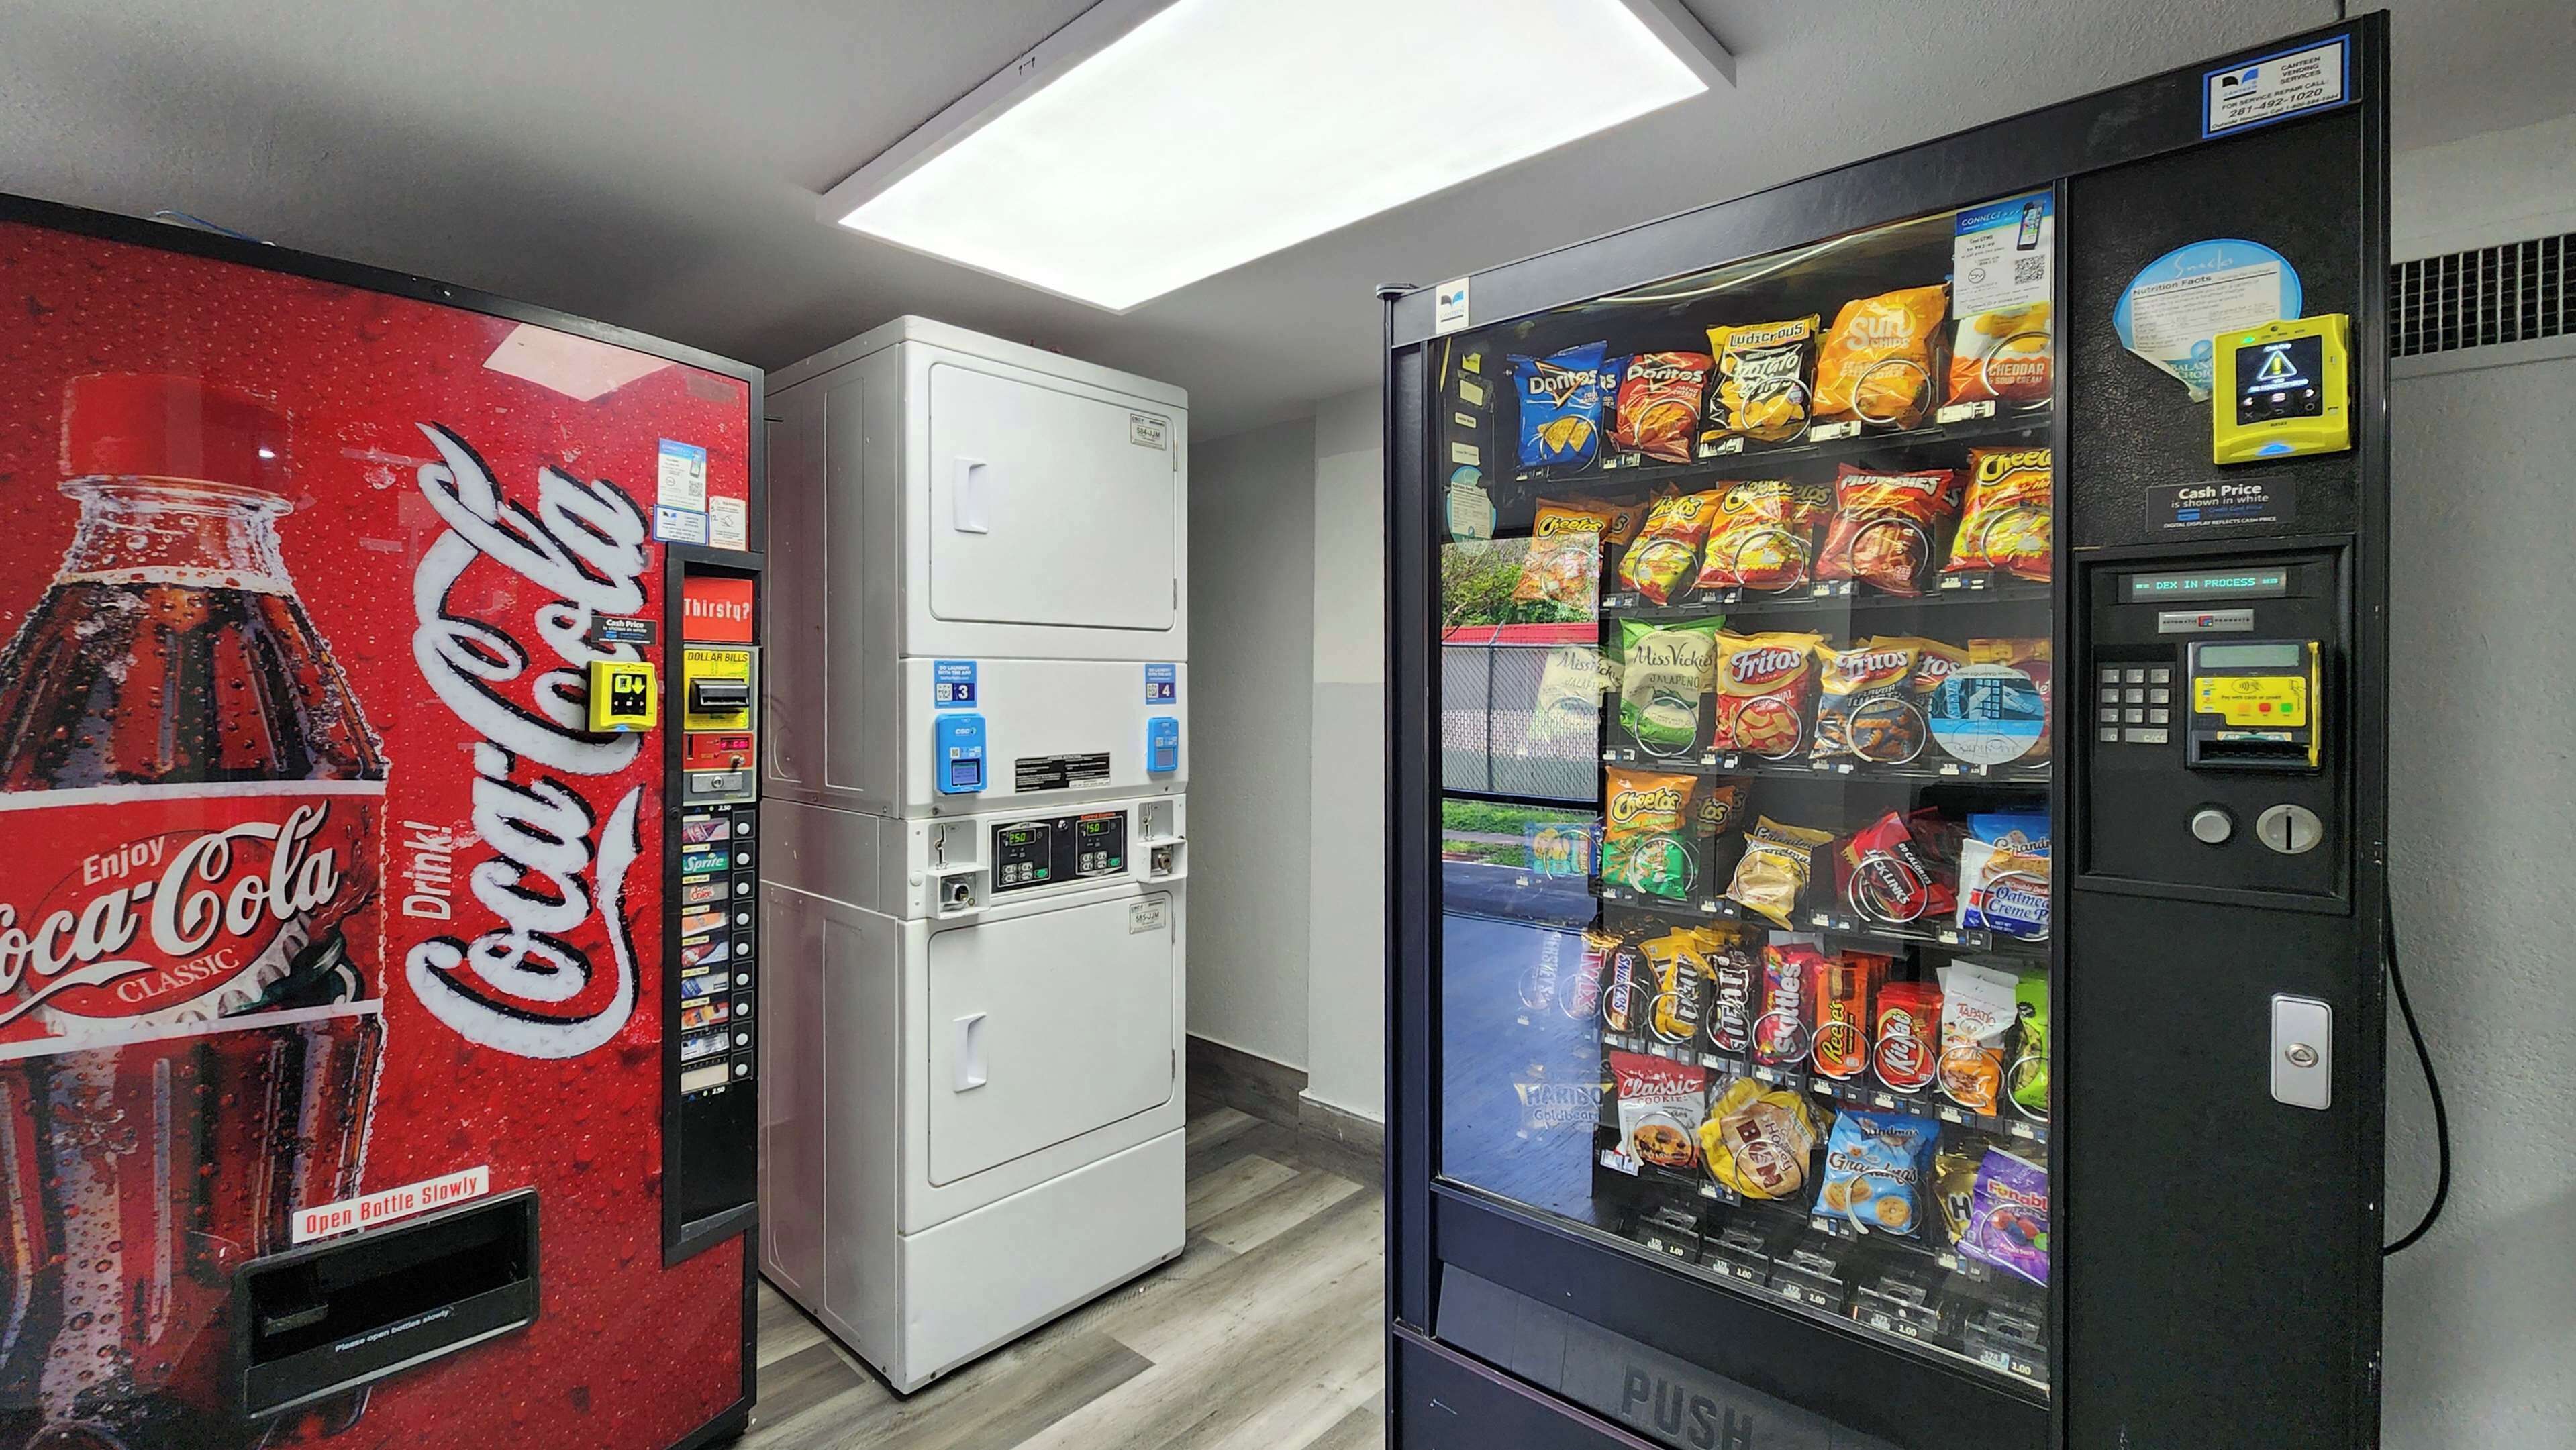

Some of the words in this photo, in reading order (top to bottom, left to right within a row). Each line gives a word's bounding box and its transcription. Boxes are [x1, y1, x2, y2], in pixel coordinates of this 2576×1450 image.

[2281, 56, 2321, 70] CANTEEN
[2282, 64, 2319, 77] VENDING
[2280, 69, 2322, 85] SERVICES
[2222, 101, 2238, 111] FOR
[2240, 93, 2272, 106] SERVICE
[2274, 85, 2303, 97] REPAIR
[2228, 88, 2323, 119] 281-492-1020
[1961, 210, 2002, 227] CONNECT
[2133, 278, 2179, 296] Nutrition
[2181, 274, 2212, 287] Facts
[1846, 315, 1914, 350] Sun
[1870, 337, 1911, 349] CHIPS
[1626, 364, 1705, 383] Doritos
[1988, 362, 2044, 377] CHEDDAR
[1993, 376, 2015, 384] SOUR
[2016, 375, 2043, 383] CREAM
[1529, 370, 1598, 395] Doritos
[2171, 499, 2181, 508] is
[2180, 497, 2219, 508] shown
[2222, 497, 2233, 505] in
[2236, 493, 2269, 503] white
[2178, 485, 2216, 499] Cash
[2220, 483, 2263, 496] Price
[1537, 515, 1604, 538] Cheetos
[2156, 580, 2177, 590] DEX
[2184, 579, 2199, 589] IN
[2204, 577, 2256, 588] PROCESS
[683, 597, 751, 623] Thirsty?
[605, 619, 624, 628] Cash
[625, 620, 645, 629] Price
[687, 652, 724, 663] DOLLAR
[724, 652, 748, 663] BILLS
[1633, 645, 1671, 667] Miss
[1730, 648, 1802, 682] Fritos
[958, 684, 969, 700] 3
[1162, 684, 1171, 697] 4
[1612, 787, 1681, 822] Cheetos
[83, 836, 166, 886] Enjoy
[402, 819, 454, 921] Drink!
[683, 856, 725, 873] Sprite
[0, 799, 340, 1025] oca-Cola
[1989, 898, 2032, 917] Creme
[2034, 909, 2050, 923] P
[116, 947, 240, 1004] CLASSIC
[1773, 963, 1802, 1054] Skittles
[1620, 1074, 1704, 1100] Classic
[306, 1209, 352, 1235] Open
[360, 1192, 415, 1214] Bottle
[422, 1173, 477, 1204] Slowly
[1669, 1245, 1684, 1257] 1.00
[1736, 1267, 1752, 1280] 1.00
[1809, 1293, 1826, 1305] 1.00
[335, 1336, 366, 1353] Please
[366, 1328, 389, 1345] open
[391, 1318, 421, 1335] bottles
[422, 1308, 451, 1326] slowly
[1898, 1325, 1918, 1337] 1.00
[1984, 1351, 1999, 1362] 174
[2011, 1361, 2032, 1376] 1.00
[1621, 1362, 1754, 1450] PUSH
